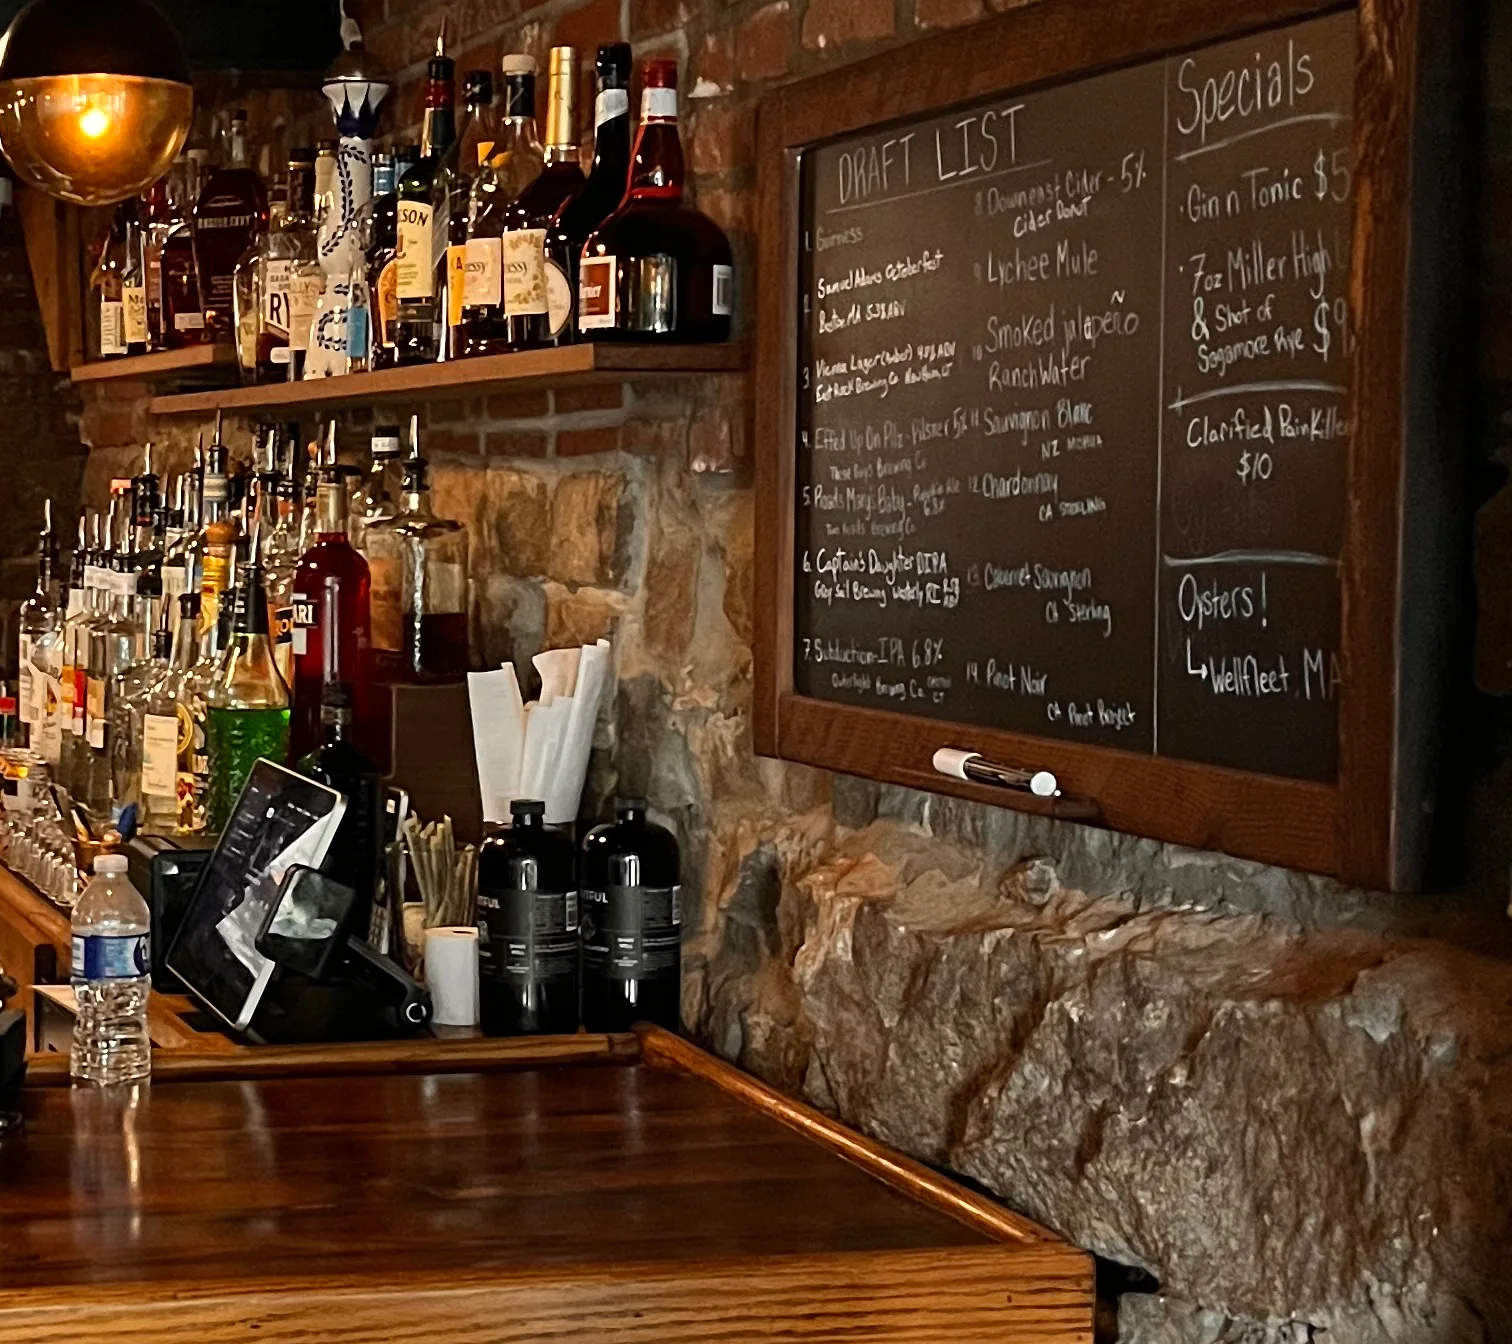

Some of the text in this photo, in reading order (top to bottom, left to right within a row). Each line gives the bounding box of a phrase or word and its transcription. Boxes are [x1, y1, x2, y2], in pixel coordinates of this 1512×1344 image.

[1177, 37, 1314, 143] Specials
[839, 103, 1026, 204] DRAFT LIST
[988, 173, 1061, 215] Downeast
[1065, 168, 1102, 198] Cider
[1188, 184, 1219, 223] Gin
[1240, 167, 1303, 210] Tonic
[398, 208, 428, 227] SON
[1013, 208, 1052, 238] Cider
[988, 247, 1050, 292] Lychee
[1056, 238, 1098, 278] Mule
[1228, 239, 1286, 292] Miller
[1292, 229, 1332, 299] High
[986, 304, 1055, 353] Smoked
[1191, 293, 1275, 341] & Shot of
[1274, 325, 1304, 358] Rye
[865, 425, 881, 450] On
[1187, 406, 1275, 448] Clarified
[982, 464, 1059, 503] Chardonnay
[1236, 449, 1273, 485] $10
[987, 658, 1016, 690] Pinot
[1021, 665, 1048, 696] Noir
